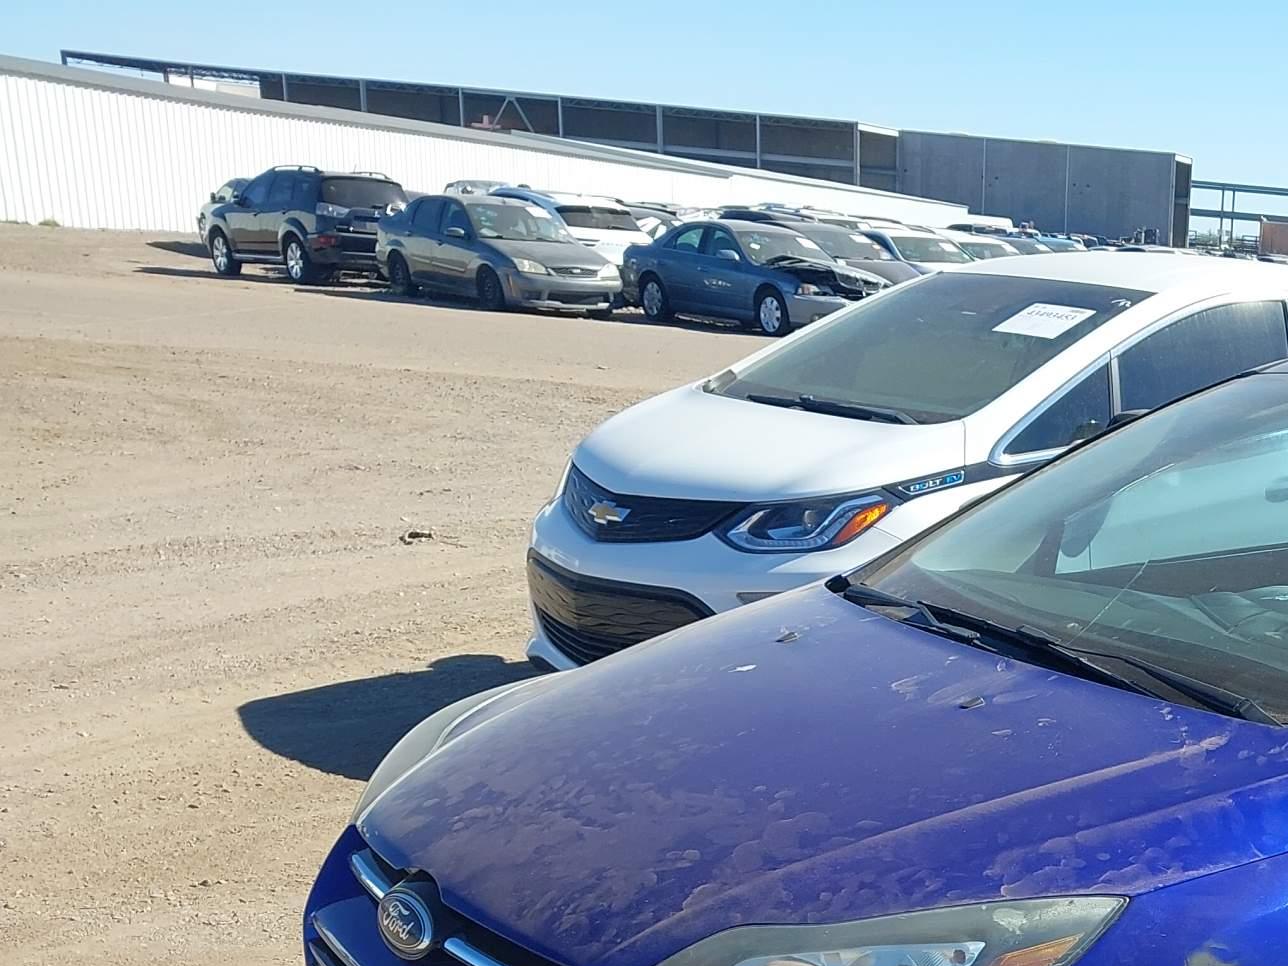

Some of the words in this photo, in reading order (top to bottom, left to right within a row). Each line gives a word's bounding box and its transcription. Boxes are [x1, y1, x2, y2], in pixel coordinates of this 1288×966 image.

[910, 478, 943, 492] BOLT
[945, 474, 961, 484] EV
[382, 901, 415, 940] Ford
